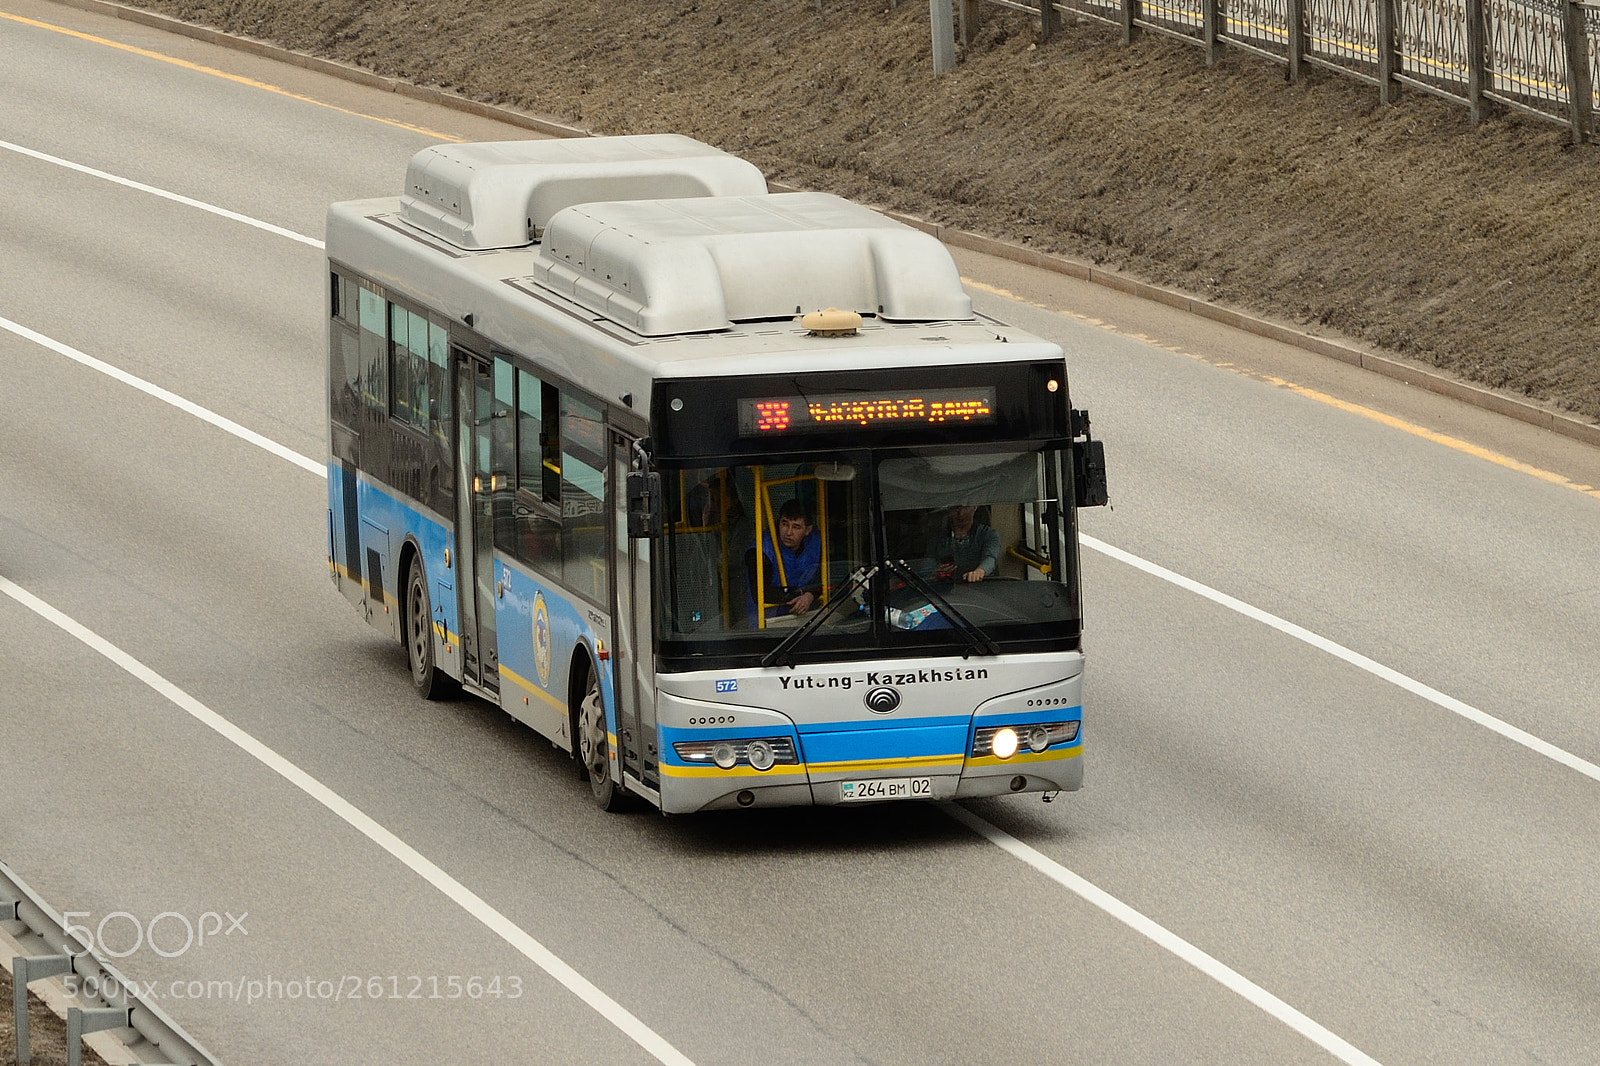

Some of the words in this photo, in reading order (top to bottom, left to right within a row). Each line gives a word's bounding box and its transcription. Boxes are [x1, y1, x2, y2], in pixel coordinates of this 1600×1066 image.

[716, 679, 738, 693] 572
[857, 782, 885, 797] 264
[889, 784, 906, 796] BM
[912, 779, 930, 794] 02
